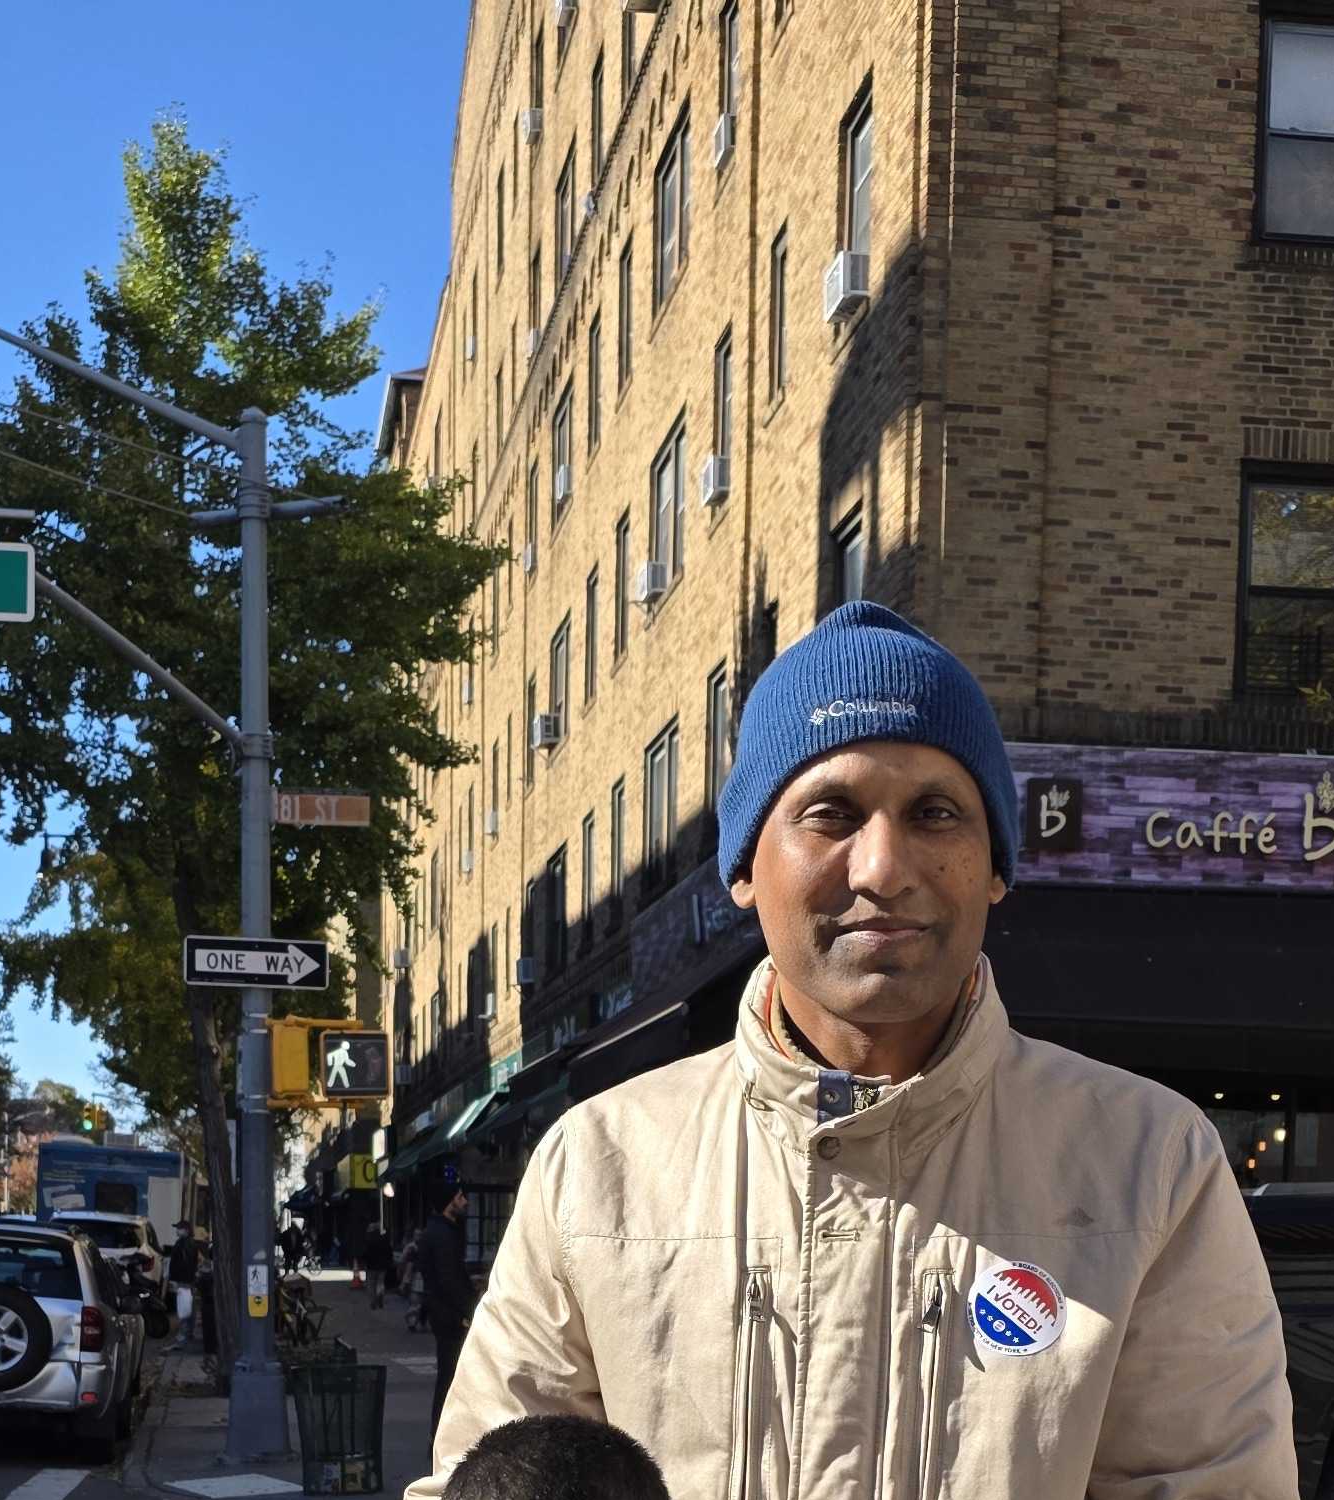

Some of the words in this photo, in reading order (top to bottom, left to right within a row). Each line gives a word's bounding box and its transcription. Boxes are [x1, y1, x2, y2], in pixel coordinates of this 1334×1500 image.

[280, 794, 300, 822] 81
[315, 796, 339, 822] ST
[1145, 808, 1278, 856] Caffé
[206, 952, 246, 971] ONE
[265, 954, 305, 974] WAY
